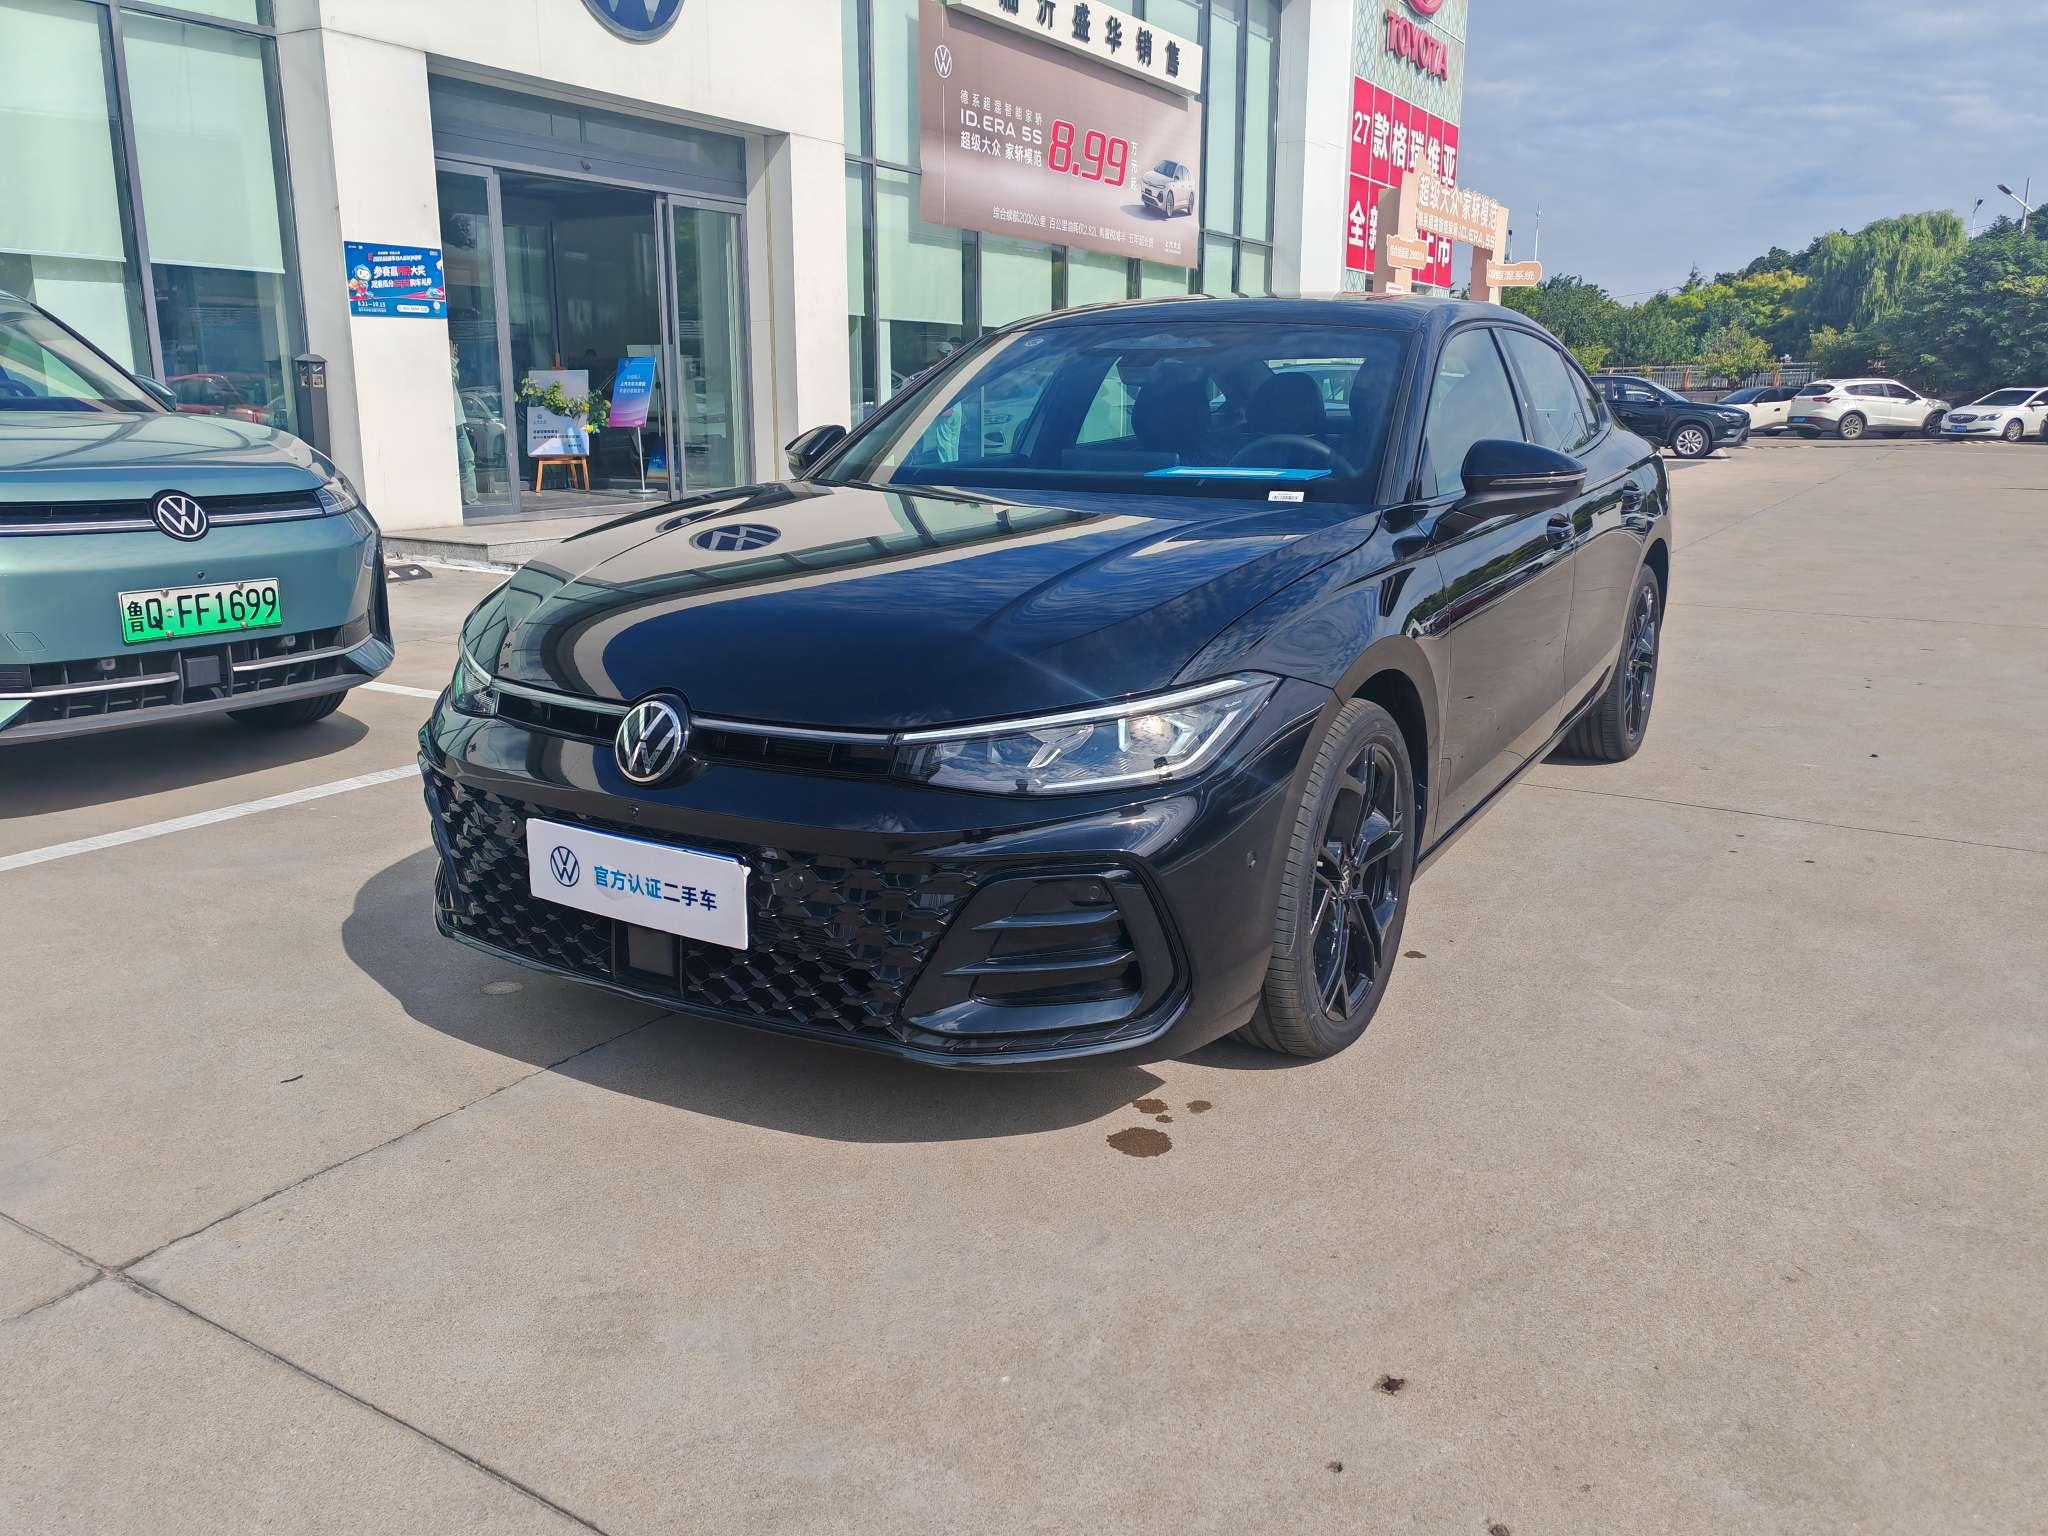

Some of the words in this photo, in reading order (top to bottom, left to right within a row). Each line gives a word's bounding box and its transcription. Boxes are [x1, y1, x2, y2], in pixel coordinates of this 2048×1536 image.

[1385, 9, 1447, 81] TOYOTA
[960, 88, 1042, 126] 德系超混智能家轿
[960, 108, 1016, 139] ID.ERA
[1021, 126, 1043, 145] 5S
[960, 130, 1001, 158] 超级大众
[1004, 142, 1042, 168] 家轿模范
[1048, 118, 1129, 188] 8.99
[593, 865, 719, 912] 官方认证二手车
